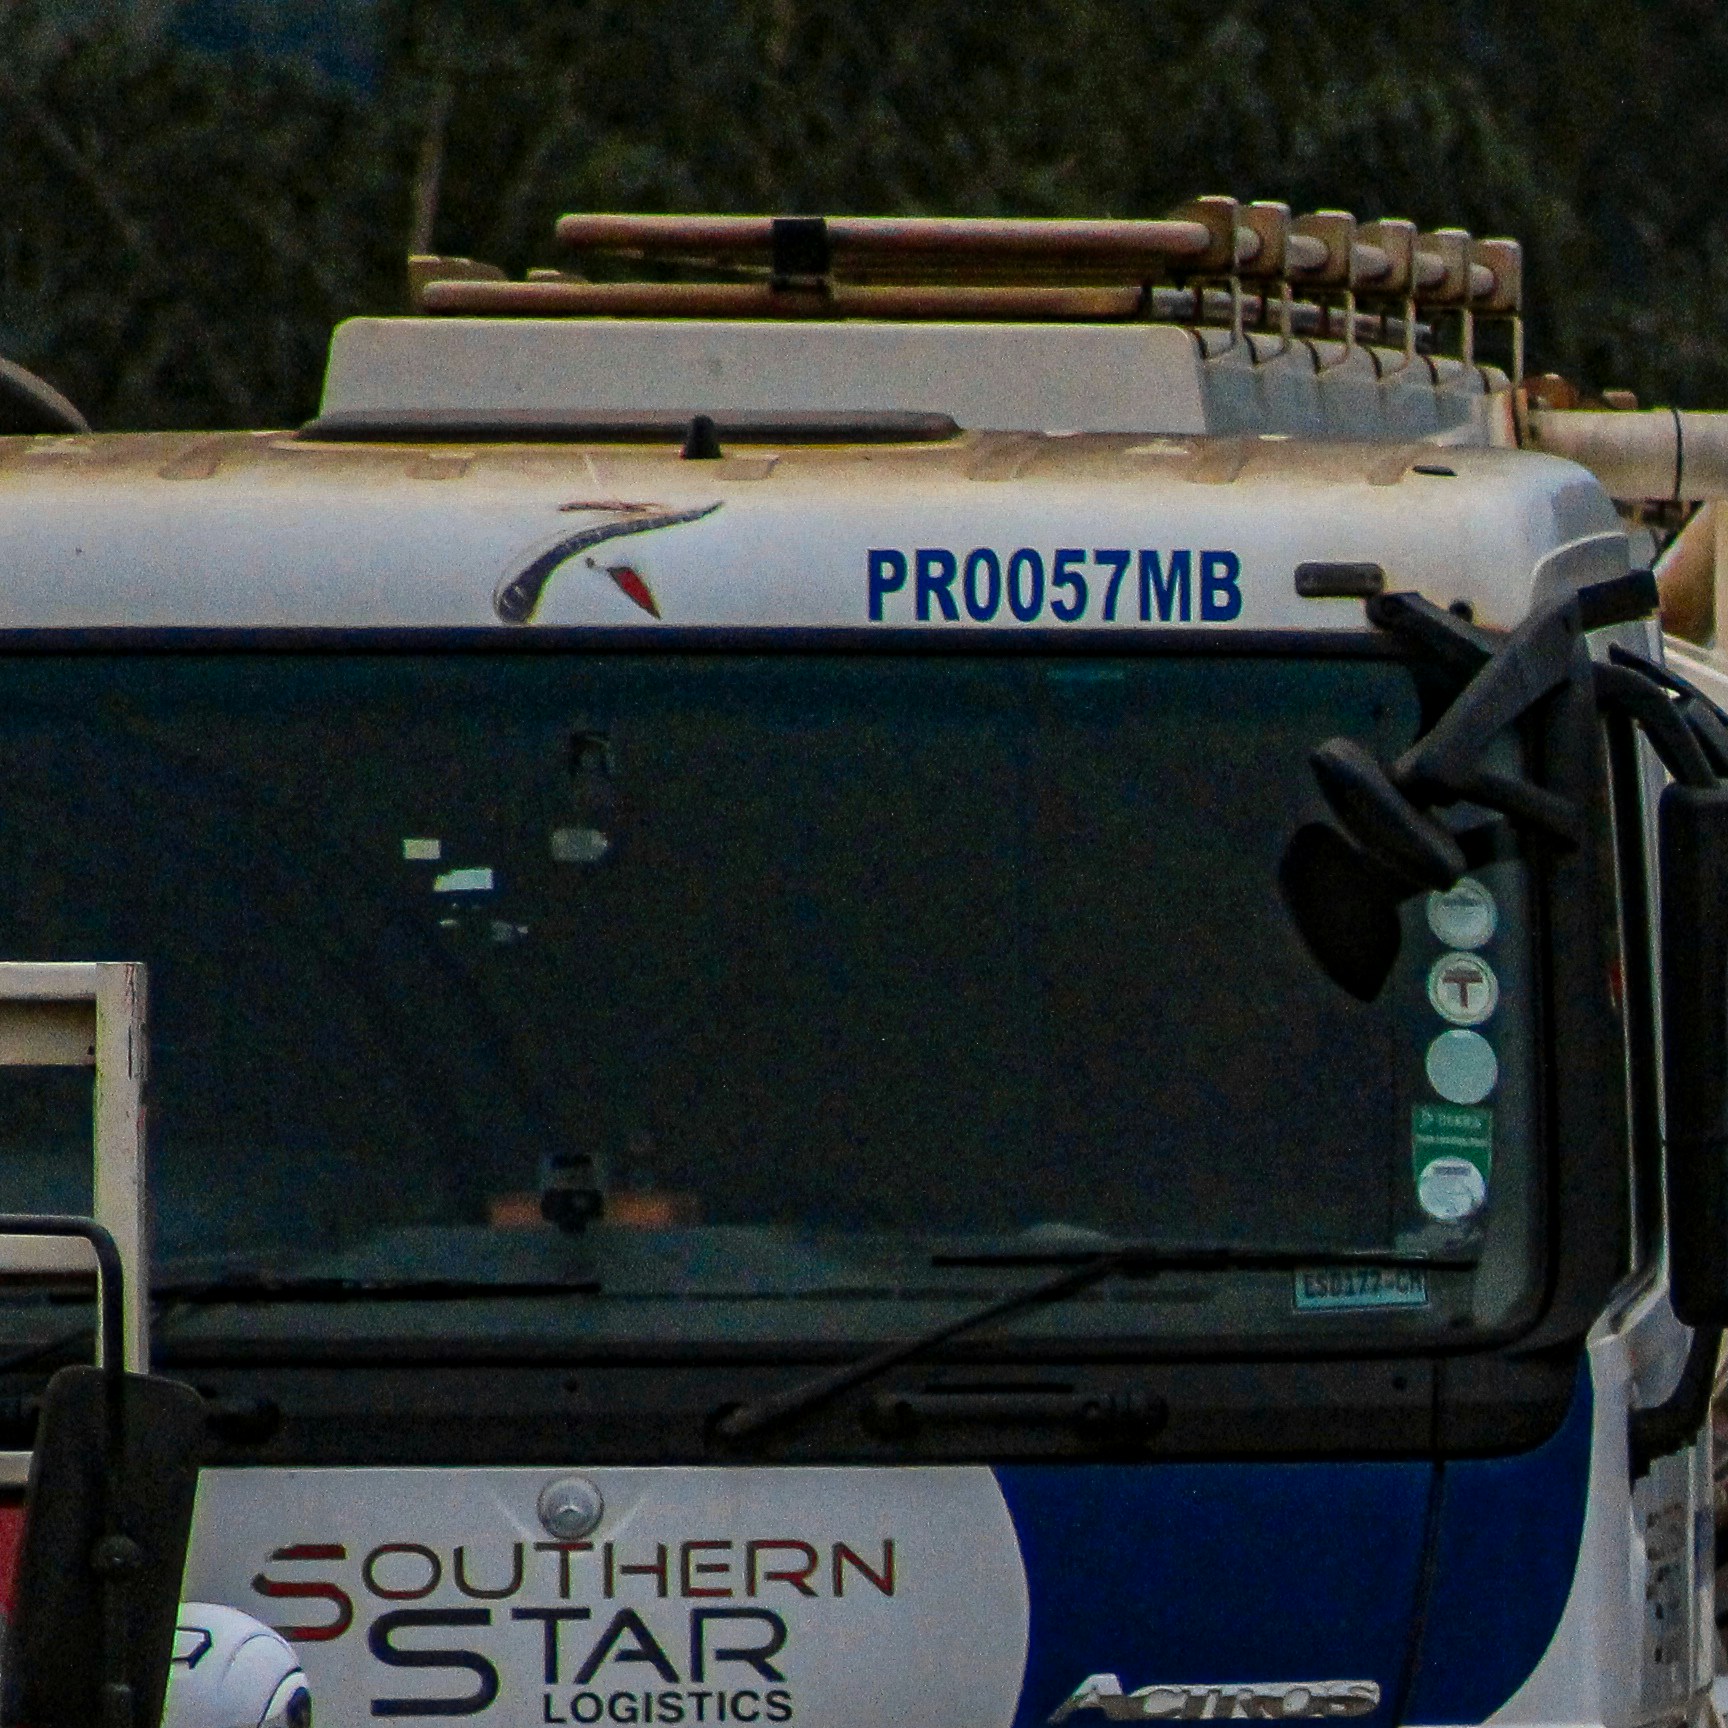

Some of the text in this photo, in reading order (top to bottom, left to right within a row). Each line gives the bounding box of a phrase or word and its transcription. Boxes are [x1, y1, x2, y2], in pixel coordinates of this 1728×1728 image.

[866, 548, 1243, 623] PR0057MB
[251, 1540, 894, 1643] SOUTHERN
[368, 1606, 789, 1718] STAR
[544, 1691, 794, 1724] LOGISTICS
